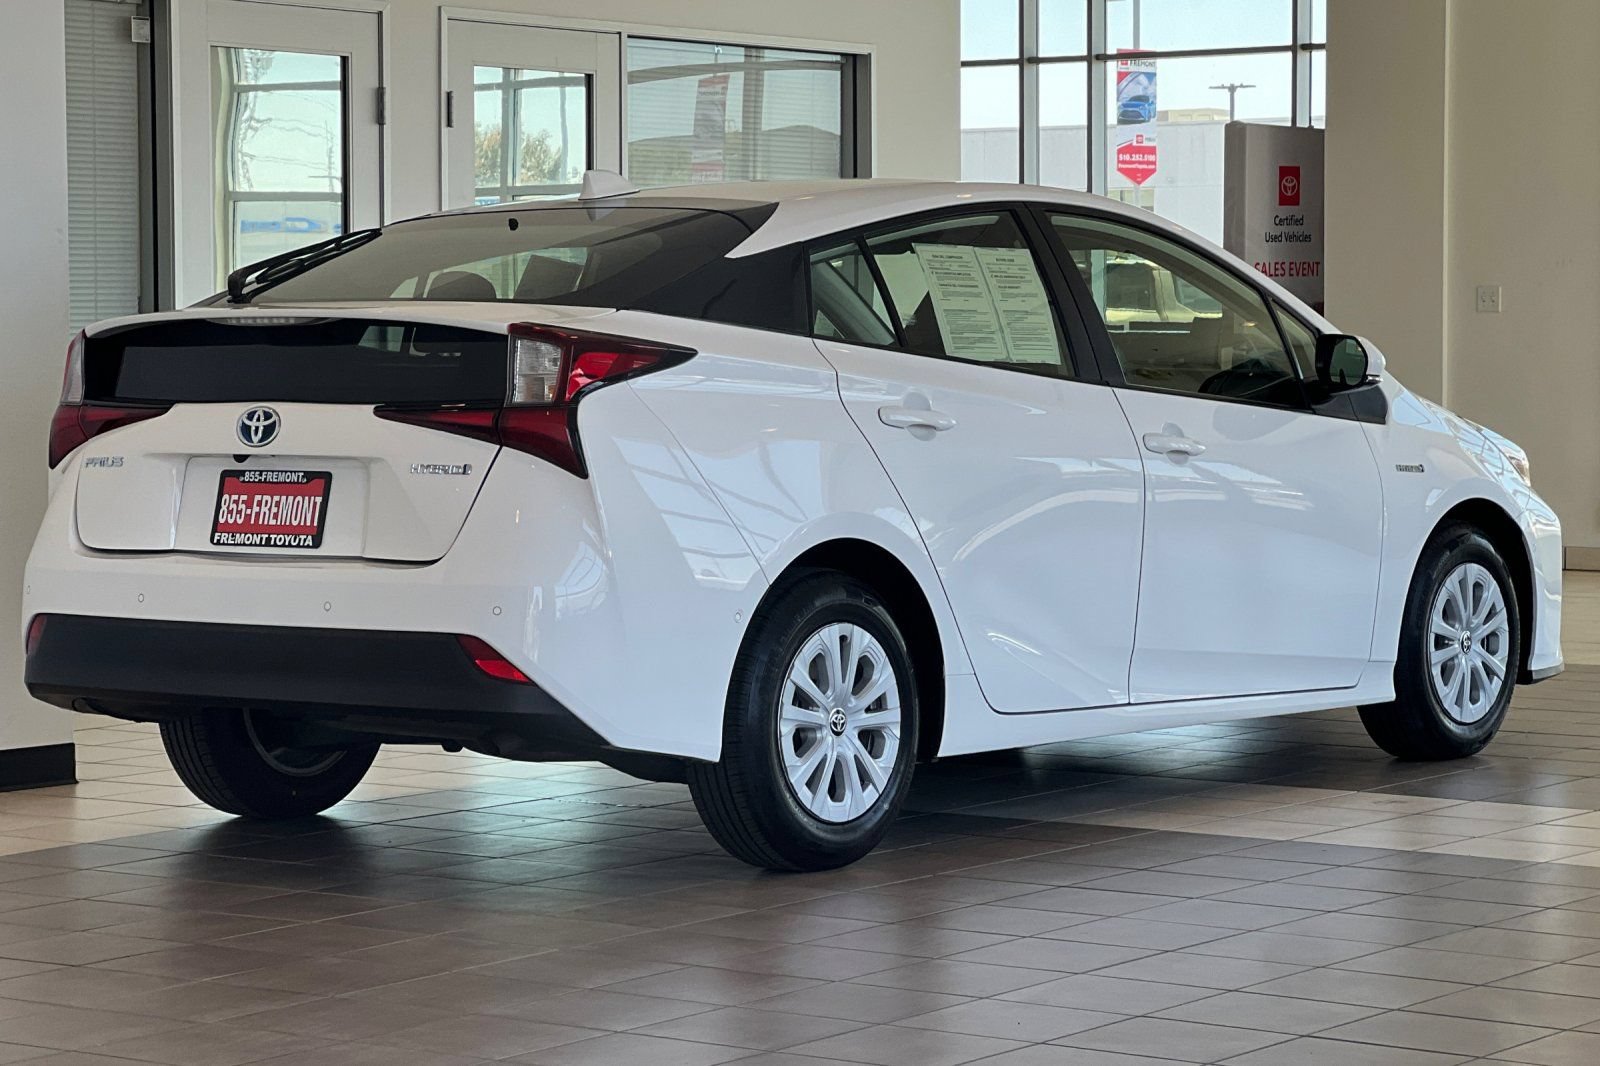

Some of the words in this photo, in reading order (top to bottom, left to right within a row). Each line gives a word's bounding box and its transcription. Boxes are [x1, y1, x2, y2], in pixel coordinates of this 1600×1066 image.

[1273, 214, 1304, 226] Certified
[1265, 231, 1283, 243] Used
[1284, 231, 1312, 243] Vehicles
[1289, 261, 1320, 277] EVENT
[244, 471, 304, 483] 855-FREMONT
[218, 493, 323, 527] 855-FREMONT
[213, 532, 269, 545] FREMONT
[269, 534, 313, 547] TOYOTA
